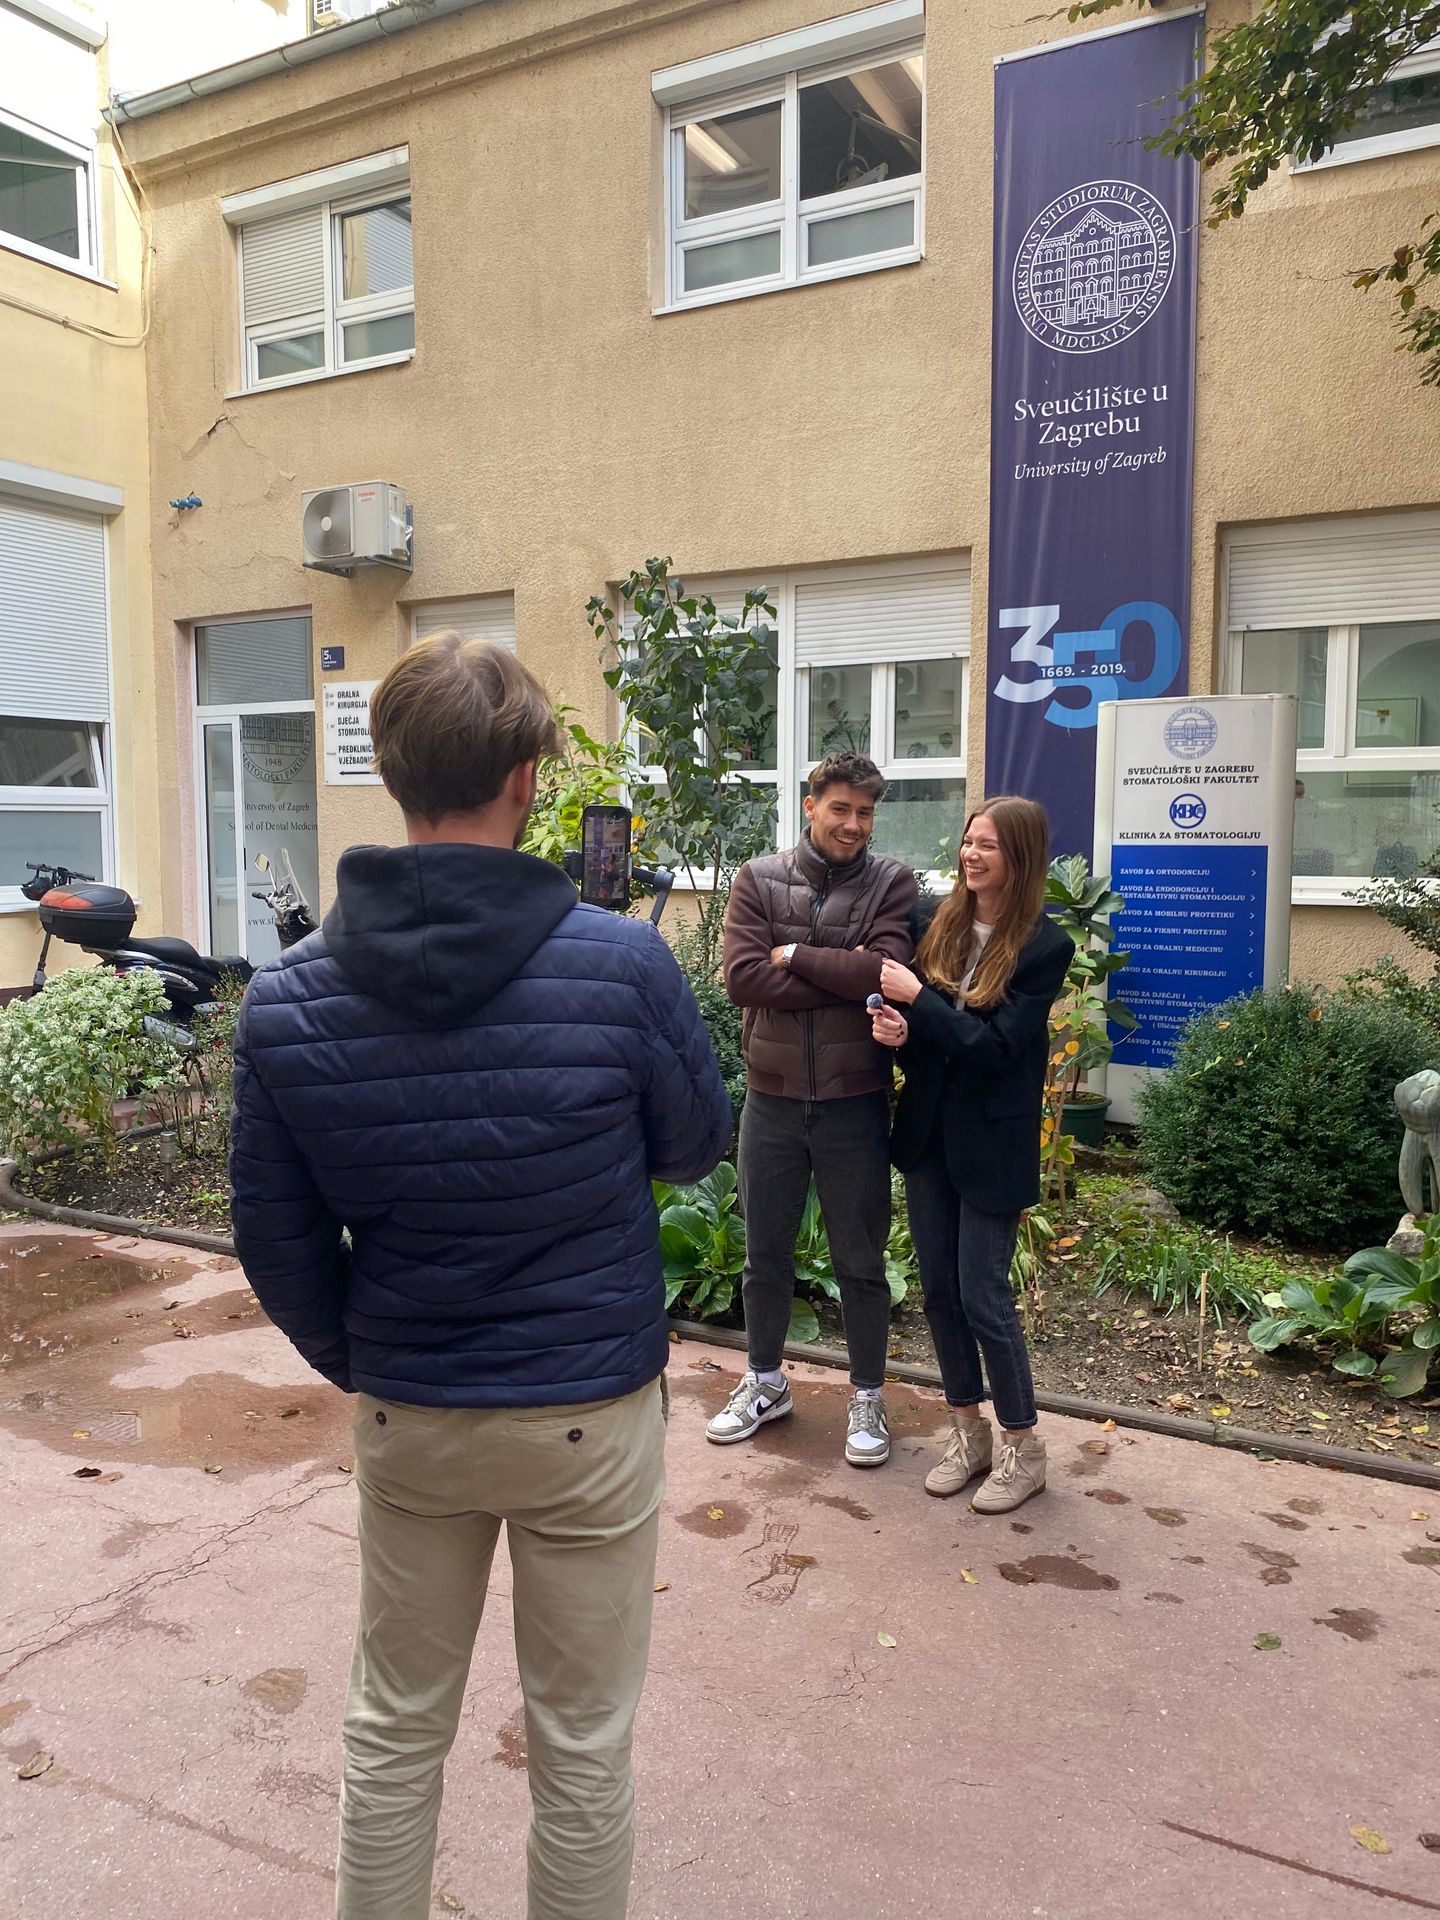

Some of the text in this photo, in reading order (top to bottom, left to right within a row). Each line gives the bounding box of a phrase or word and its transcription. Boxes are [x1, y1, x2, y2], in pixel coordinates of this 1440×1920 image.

[1017, 185, 1171, 336] UNIVERSITAS STUDIORUM ZAGRABIENSIS
[1051, 320, 1132, 349] MDCLXIX
[1014, 384, 1168, 421] Sveučilište u
[1038, 411, 1141, 448] Zagrebu
[1014, 446, 1167, 480] University of Zagreb
[993, 600, 1181, 729] 350
[1041, 667, 1075, 678] 1669.
[1090, 663, 1126, 675] 2019.
[337, 690, 360, 699] ORALNA
[337, 701, 368, 709] KIRURGIJA
[337, 716, 360, 725] DJEČJA
[338, 743, 374, 753] PREDKLINIČ
[242, 738, 311, 781] MATOLOŠKI FAKULTET
[264, 757, 282, 766] 1948
[1127, 764, 1192, 775] SVEUČILIŠTE
[1204, 765, 1255, 773] ZAGREBU
[1123, 775, 1260, 785] STOMATOLOŠKI FAKULTET
[278, 802, 286, 811] of
[287, 802, 310, 813] Zagreb
[256, 821, 265, 831] of
[265, 821, 289, 831] Dental
[290, 821, 317, 831] Medicin
[247, 915, 275, 926] www.sf
[1183, 928, 1227, 936] PROTETIKU
[1185, 945, 1224, 953] MEDICINU
[1184, 969, 1227, 977] KIRURGIJU
